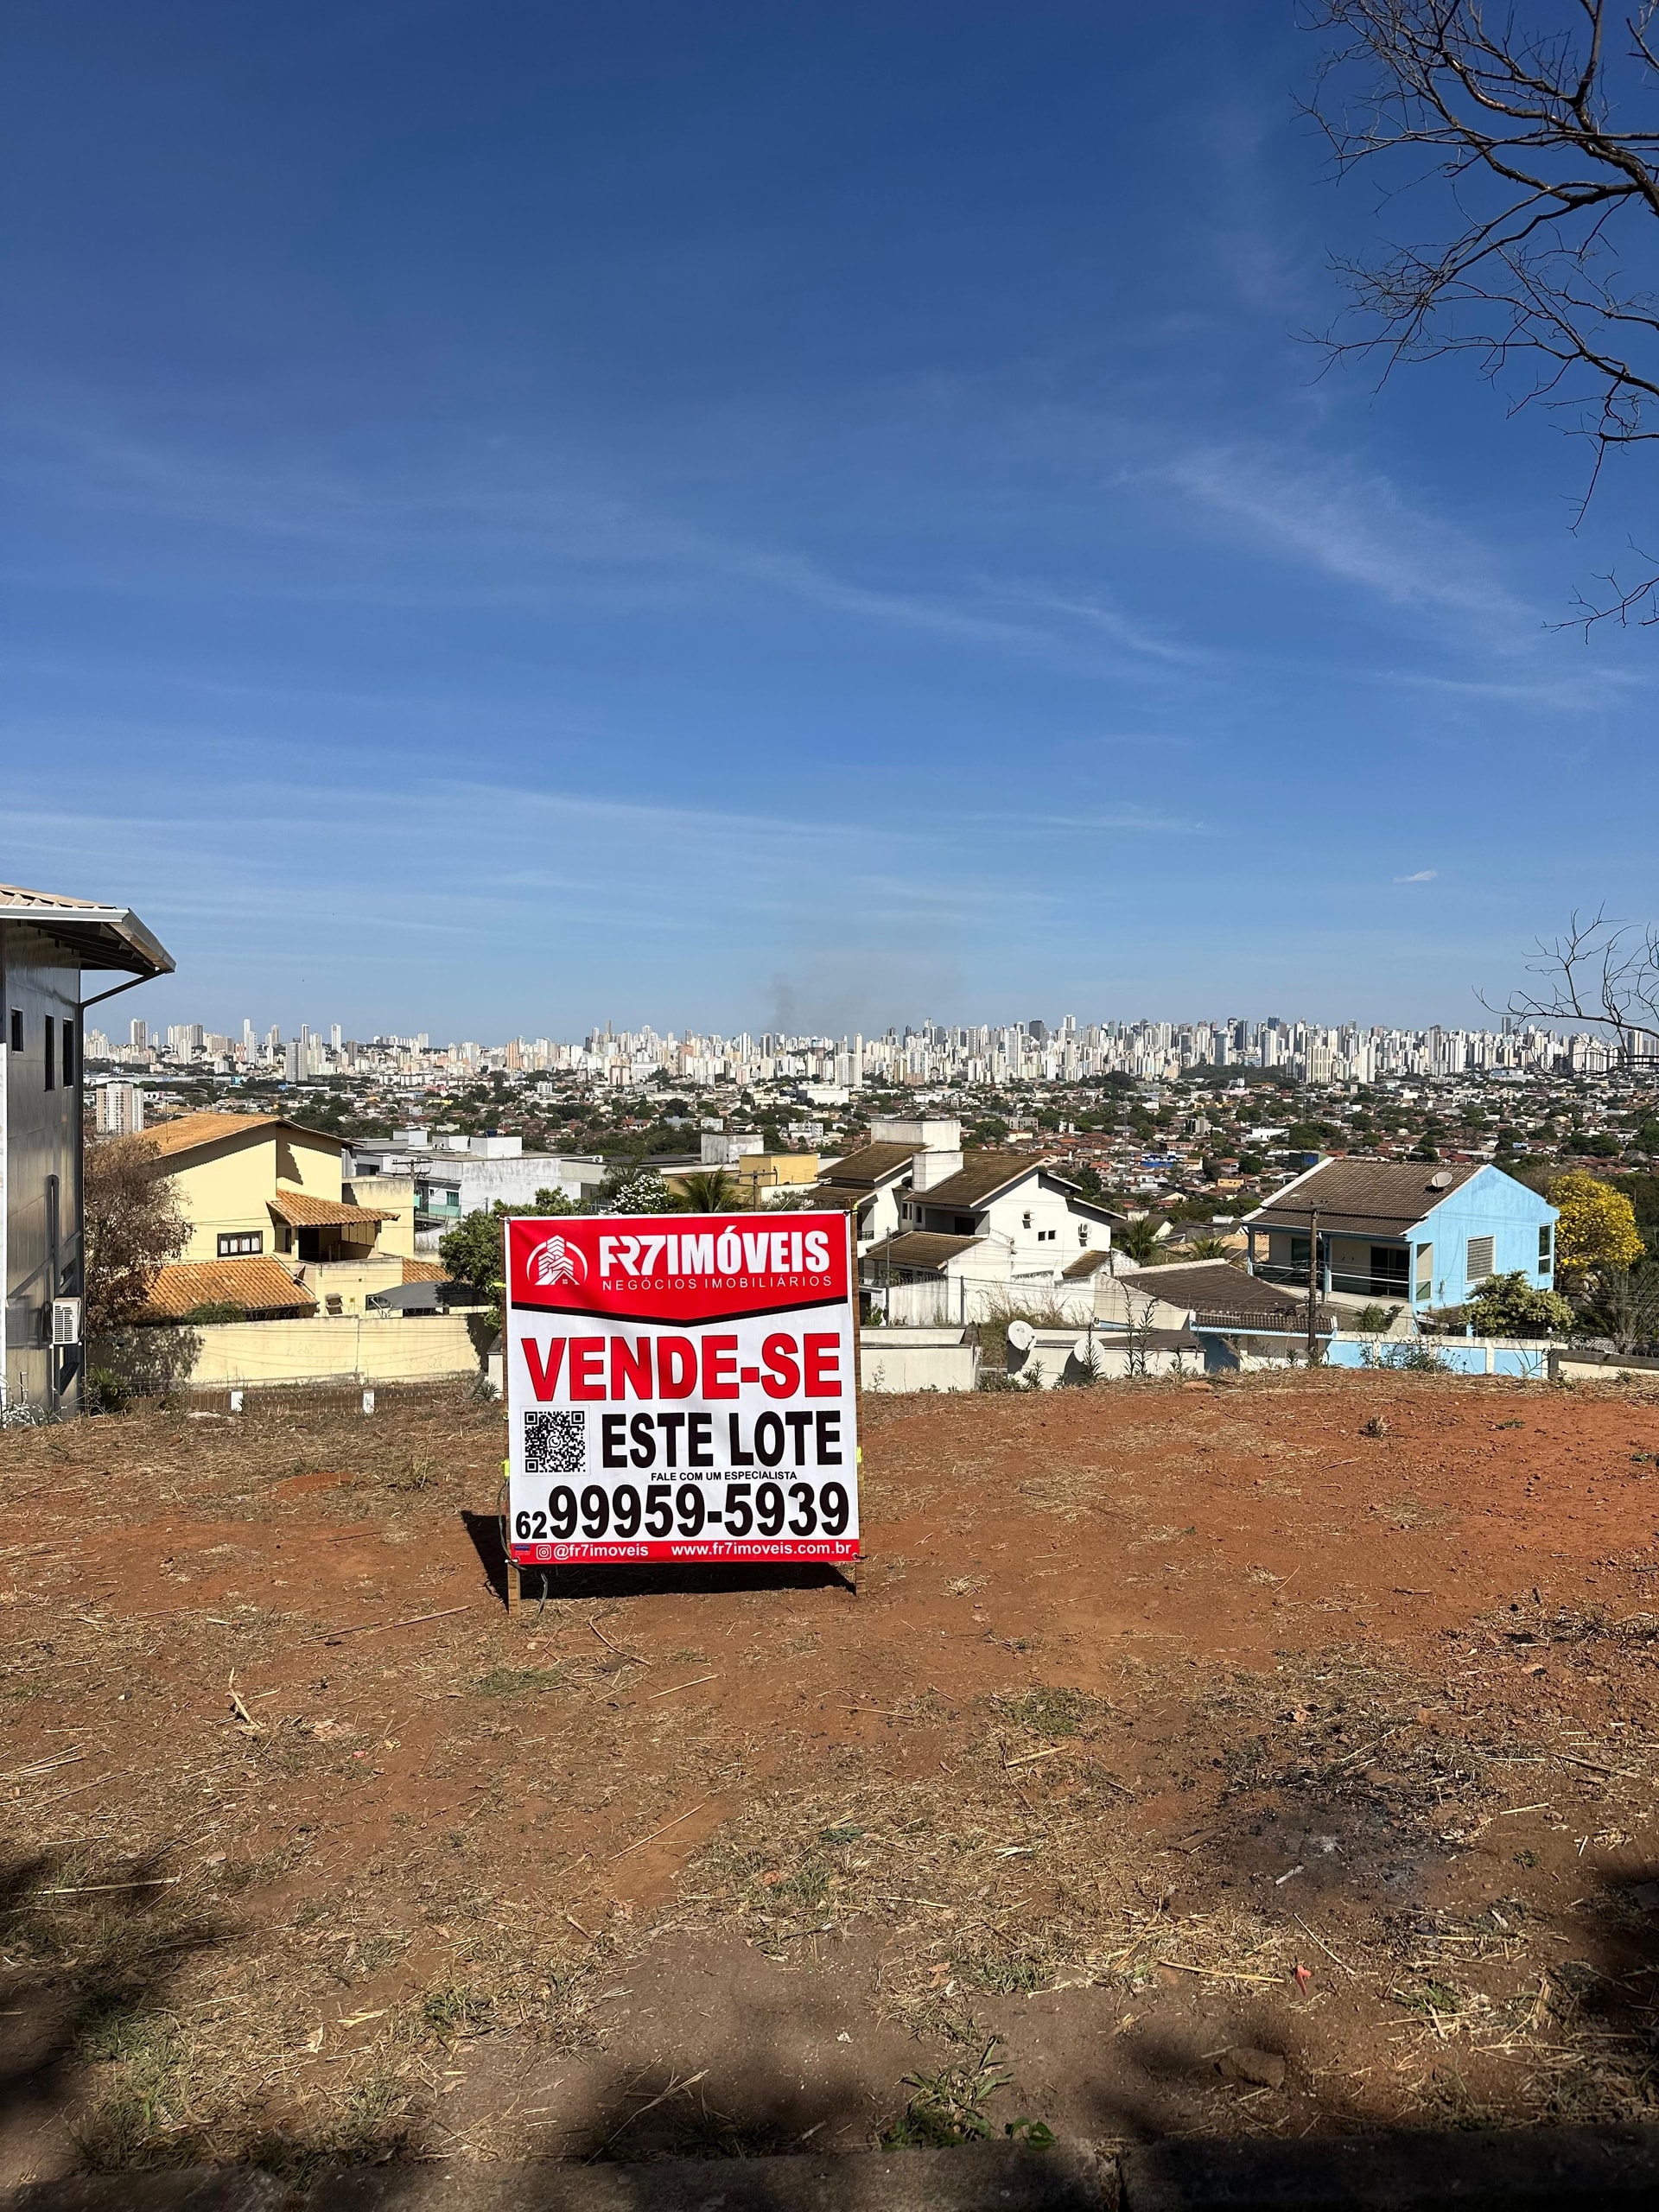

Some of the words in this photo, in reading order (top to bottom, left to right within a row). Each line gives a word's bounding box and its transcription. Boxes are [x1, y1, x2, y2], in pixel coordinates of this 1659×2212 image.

[602, 1276, 697, 1291] NEGÓCIOS
[704, 1274, 832, 1289] IMOBILIÁRIOS
[521, 1332, 842, 1402] VENDE-SE
[601, 1412, 714, 1469] ESTE
[728, 1410, 842, 1468] LOTE
[651, 1472, 677, 1481] FALE
[679, 1472, 702, 1481] COM
[706, 1471, 721, 1481] UM
[724, 1471, 798, 1480] ESPECIALISTA
[554, 1543, 649, 1560] @fr7imoveis
[671, 1541, 852, 1556] www.fr7imoveis.com.br
